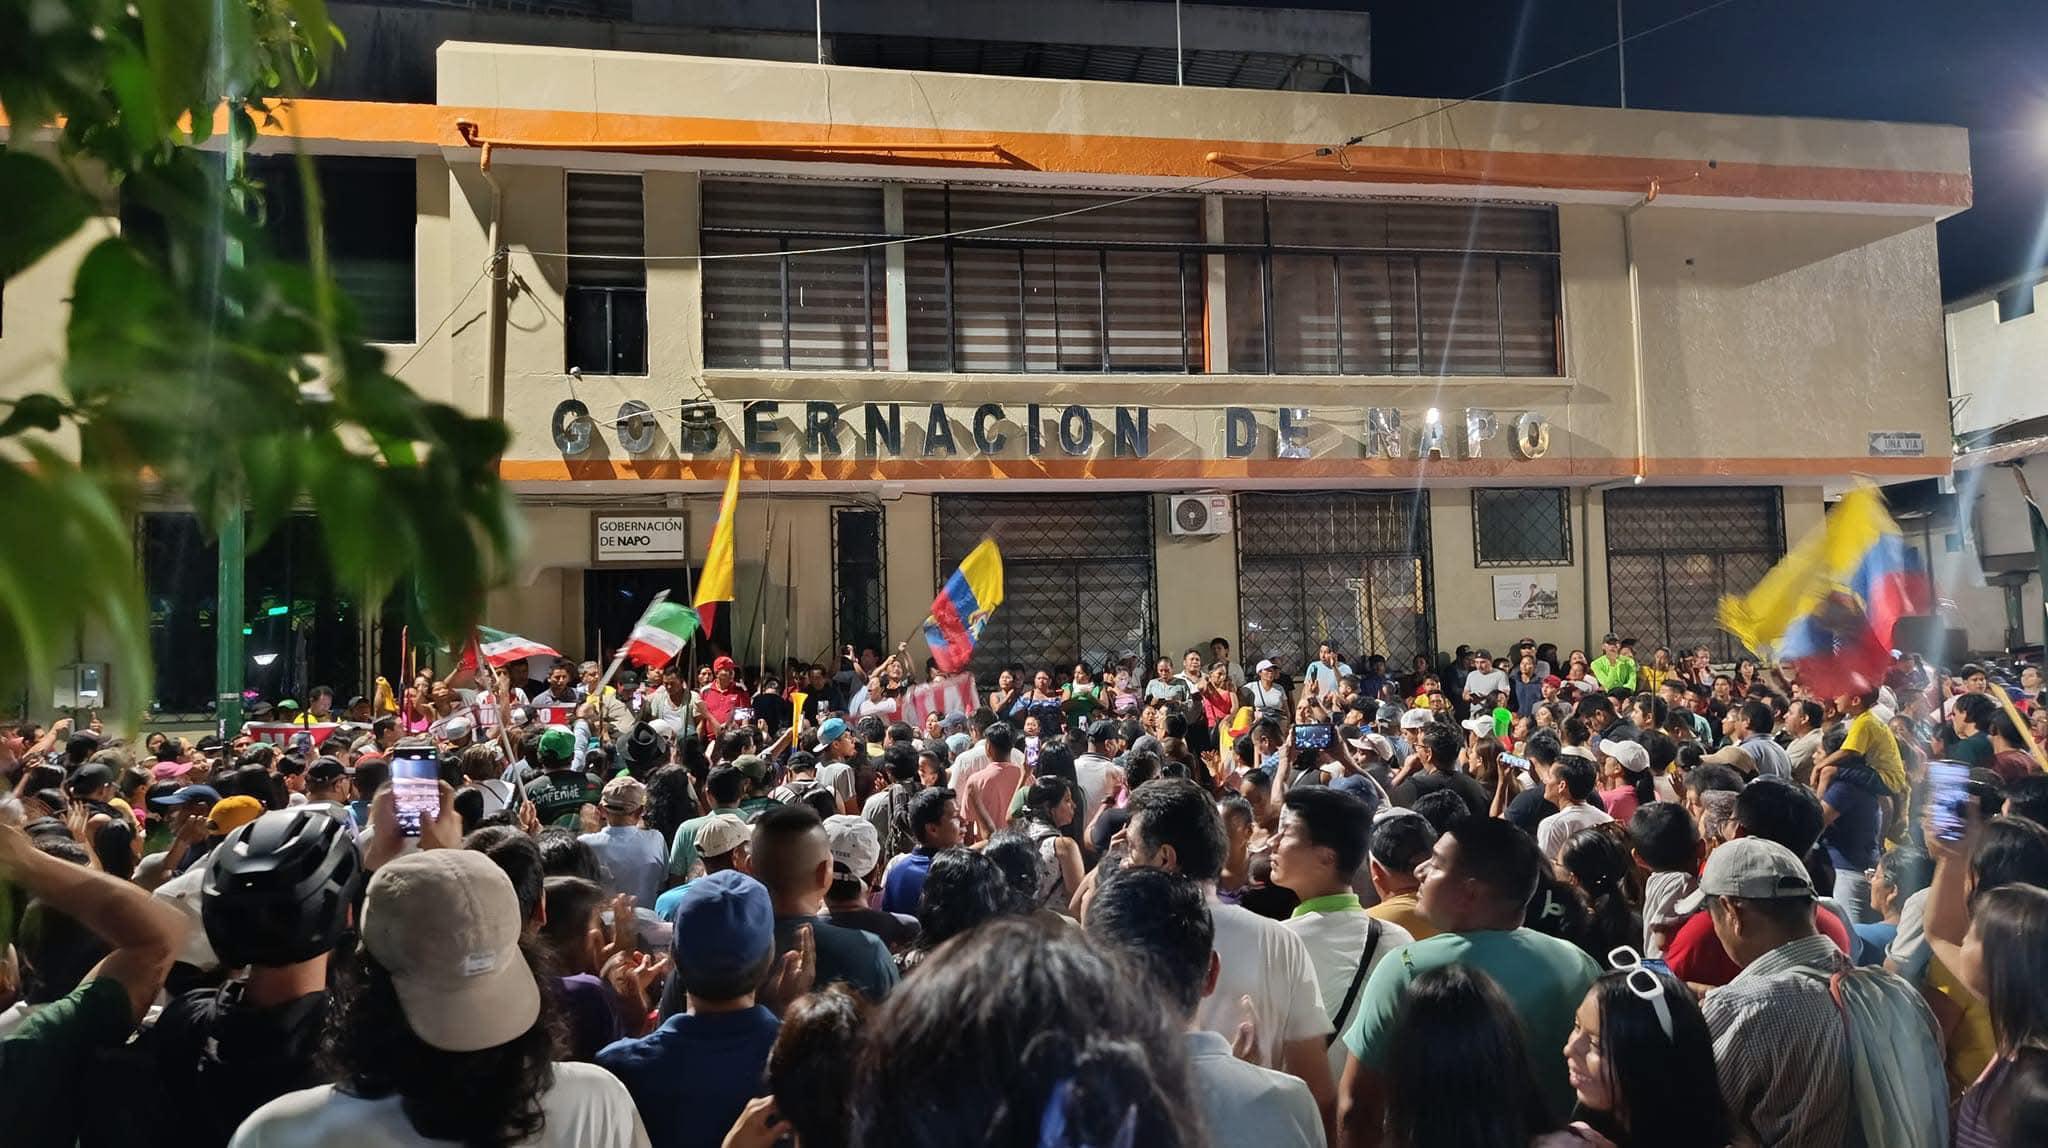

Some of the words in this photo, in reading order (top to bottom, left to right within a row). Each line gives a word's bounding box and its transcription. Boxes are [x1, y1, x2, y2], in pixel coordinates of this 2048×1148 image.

[551, 398, 1152, 459] GOBERNACION
[1223, 406, 1312, 459] DE
[1365, 406, 1551, 460] NAPO
[599, 518, 682, 532] GOBERNACIÓN
[600, 536, 615, 546] DE
[617, 535, 651, 546] NAPO
